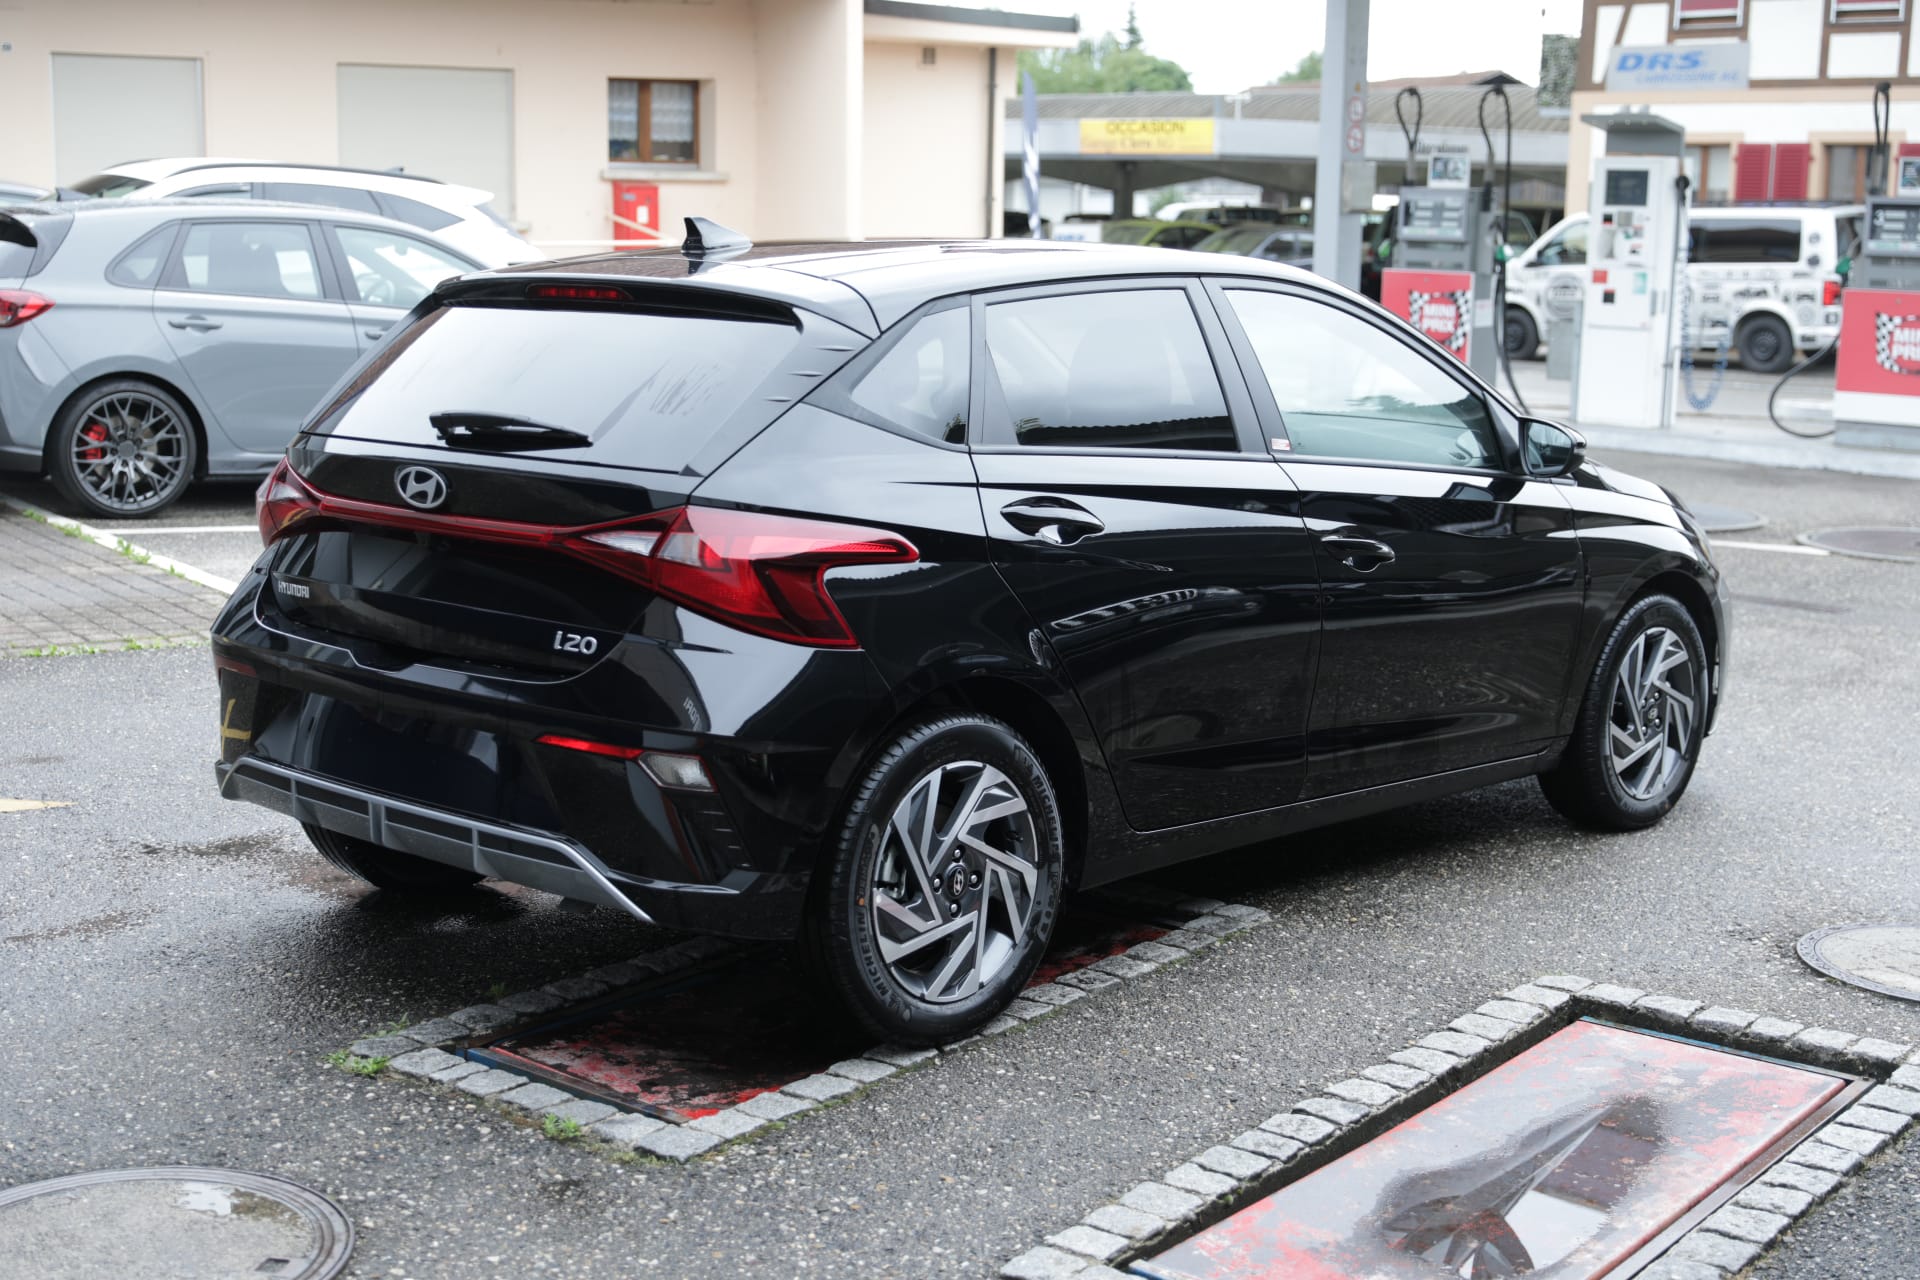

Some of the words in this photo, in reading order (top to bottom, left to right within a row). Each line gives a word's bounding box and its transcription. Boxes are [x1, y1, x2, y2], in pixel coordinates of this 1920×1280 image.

[1616, 51, 1703, 72] DRS
[1105, 120, 1184, 134] OCCASION
[1423, 304, 1456, 317] MINI
[1422, 318, 1455, 333] PRIX
[278, 580, 310, 599] HYUNDAI
[856, 911, 891, 1001] MICHELIN
